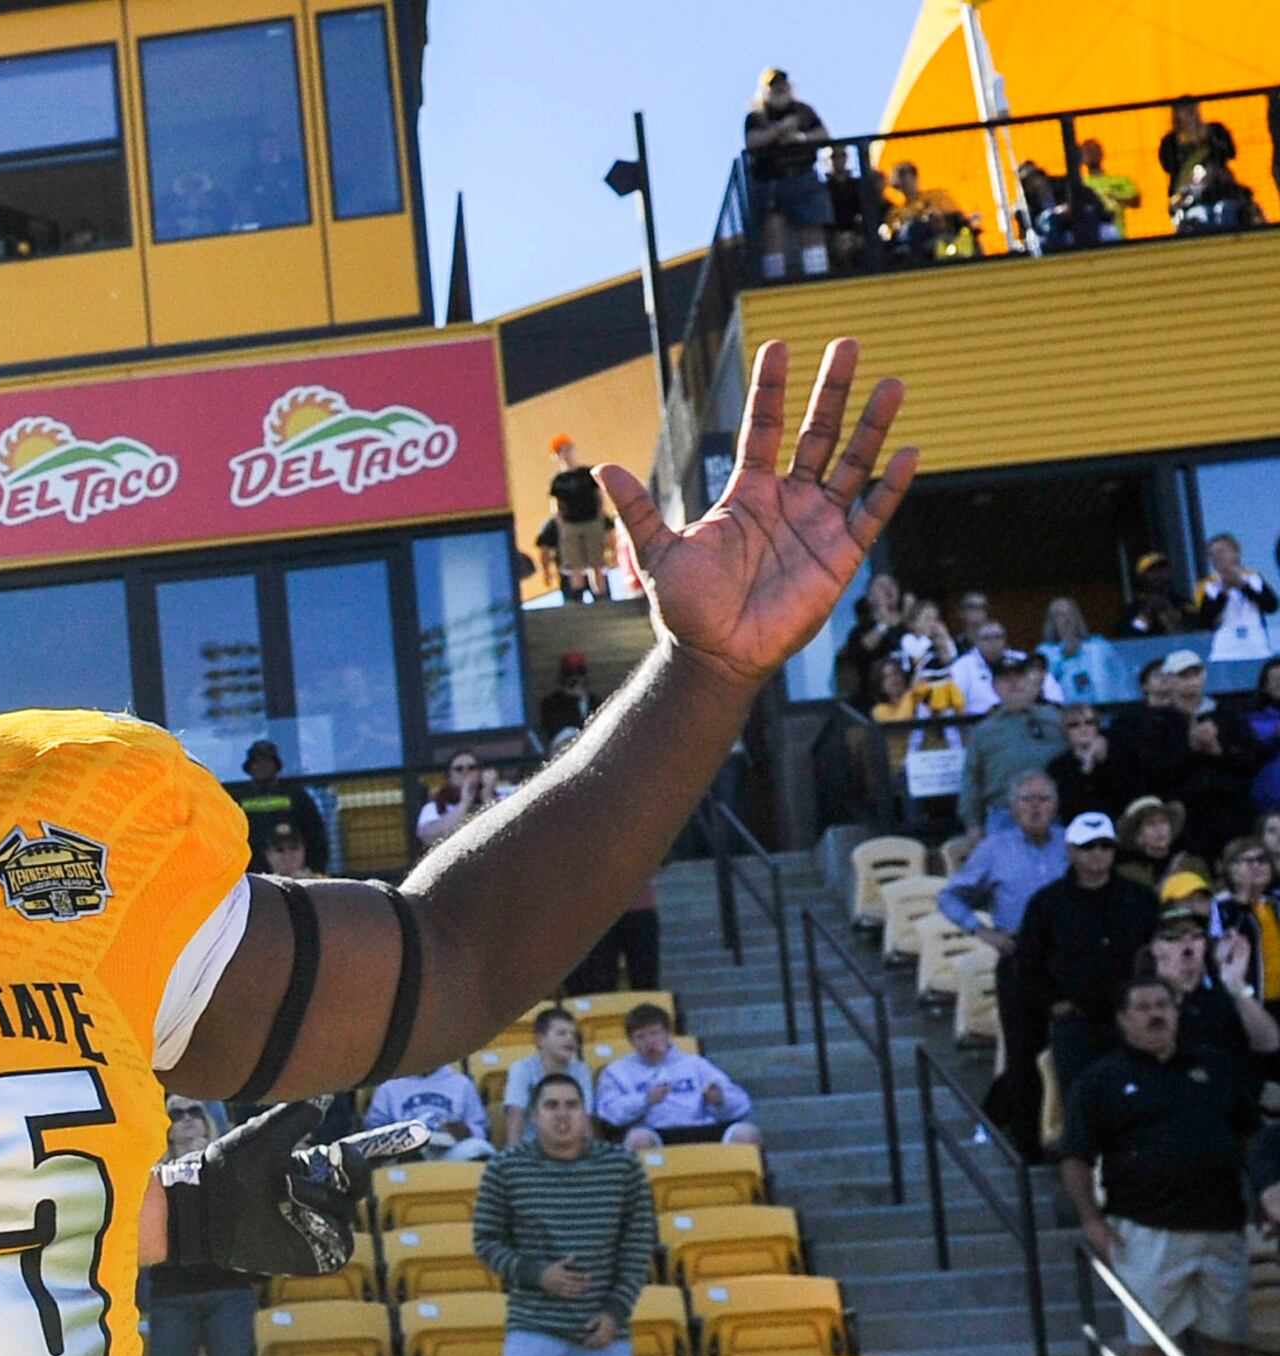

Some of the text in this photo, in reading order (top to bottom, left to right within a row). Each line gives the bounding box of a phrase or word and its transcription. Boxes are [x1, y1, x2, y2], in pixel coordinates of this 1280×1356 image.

[62, 454, 174, 518] TACO
[235, 430, 451, 501] DEL TACO
